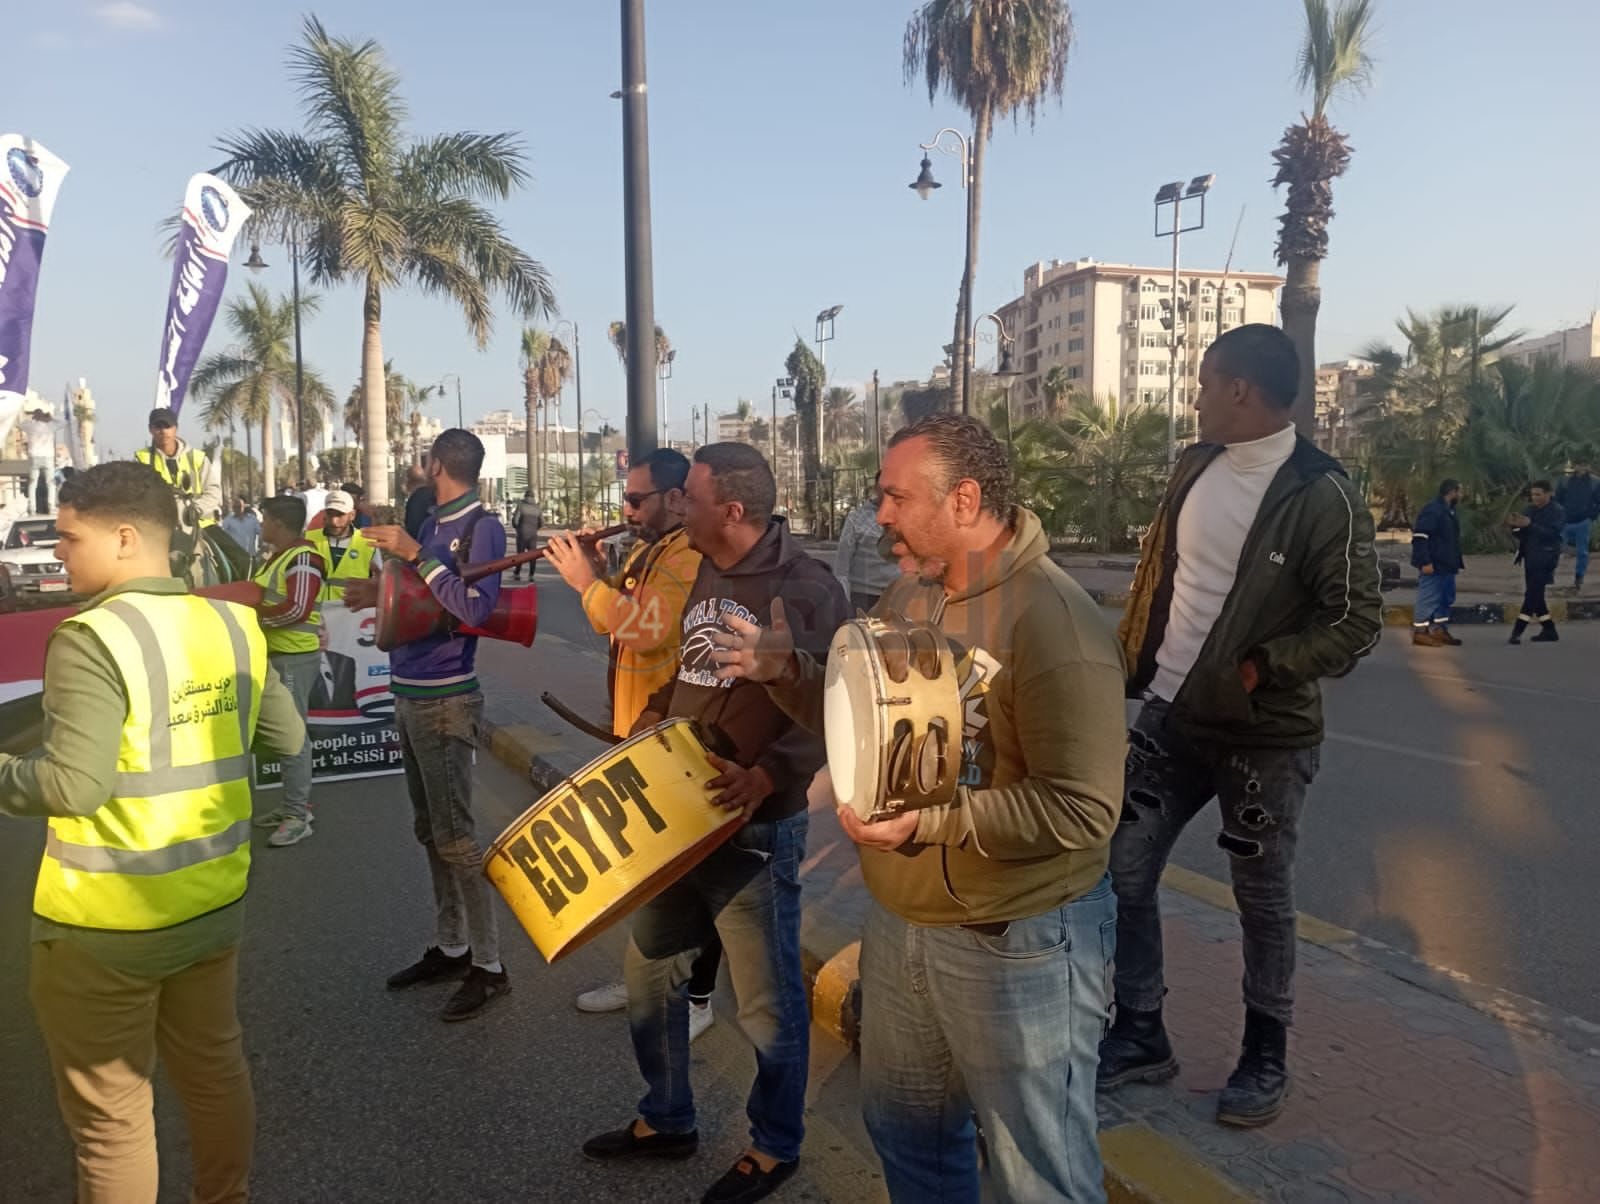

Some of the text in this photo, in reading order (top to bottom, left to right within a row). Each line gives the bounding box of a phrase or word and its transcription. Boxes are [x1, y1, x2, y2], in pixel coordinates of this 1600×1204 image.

[360, 731, 377, 746] in
[380, 729, 400, 744] Po
[507, 756, 668, 918] EGYPT
